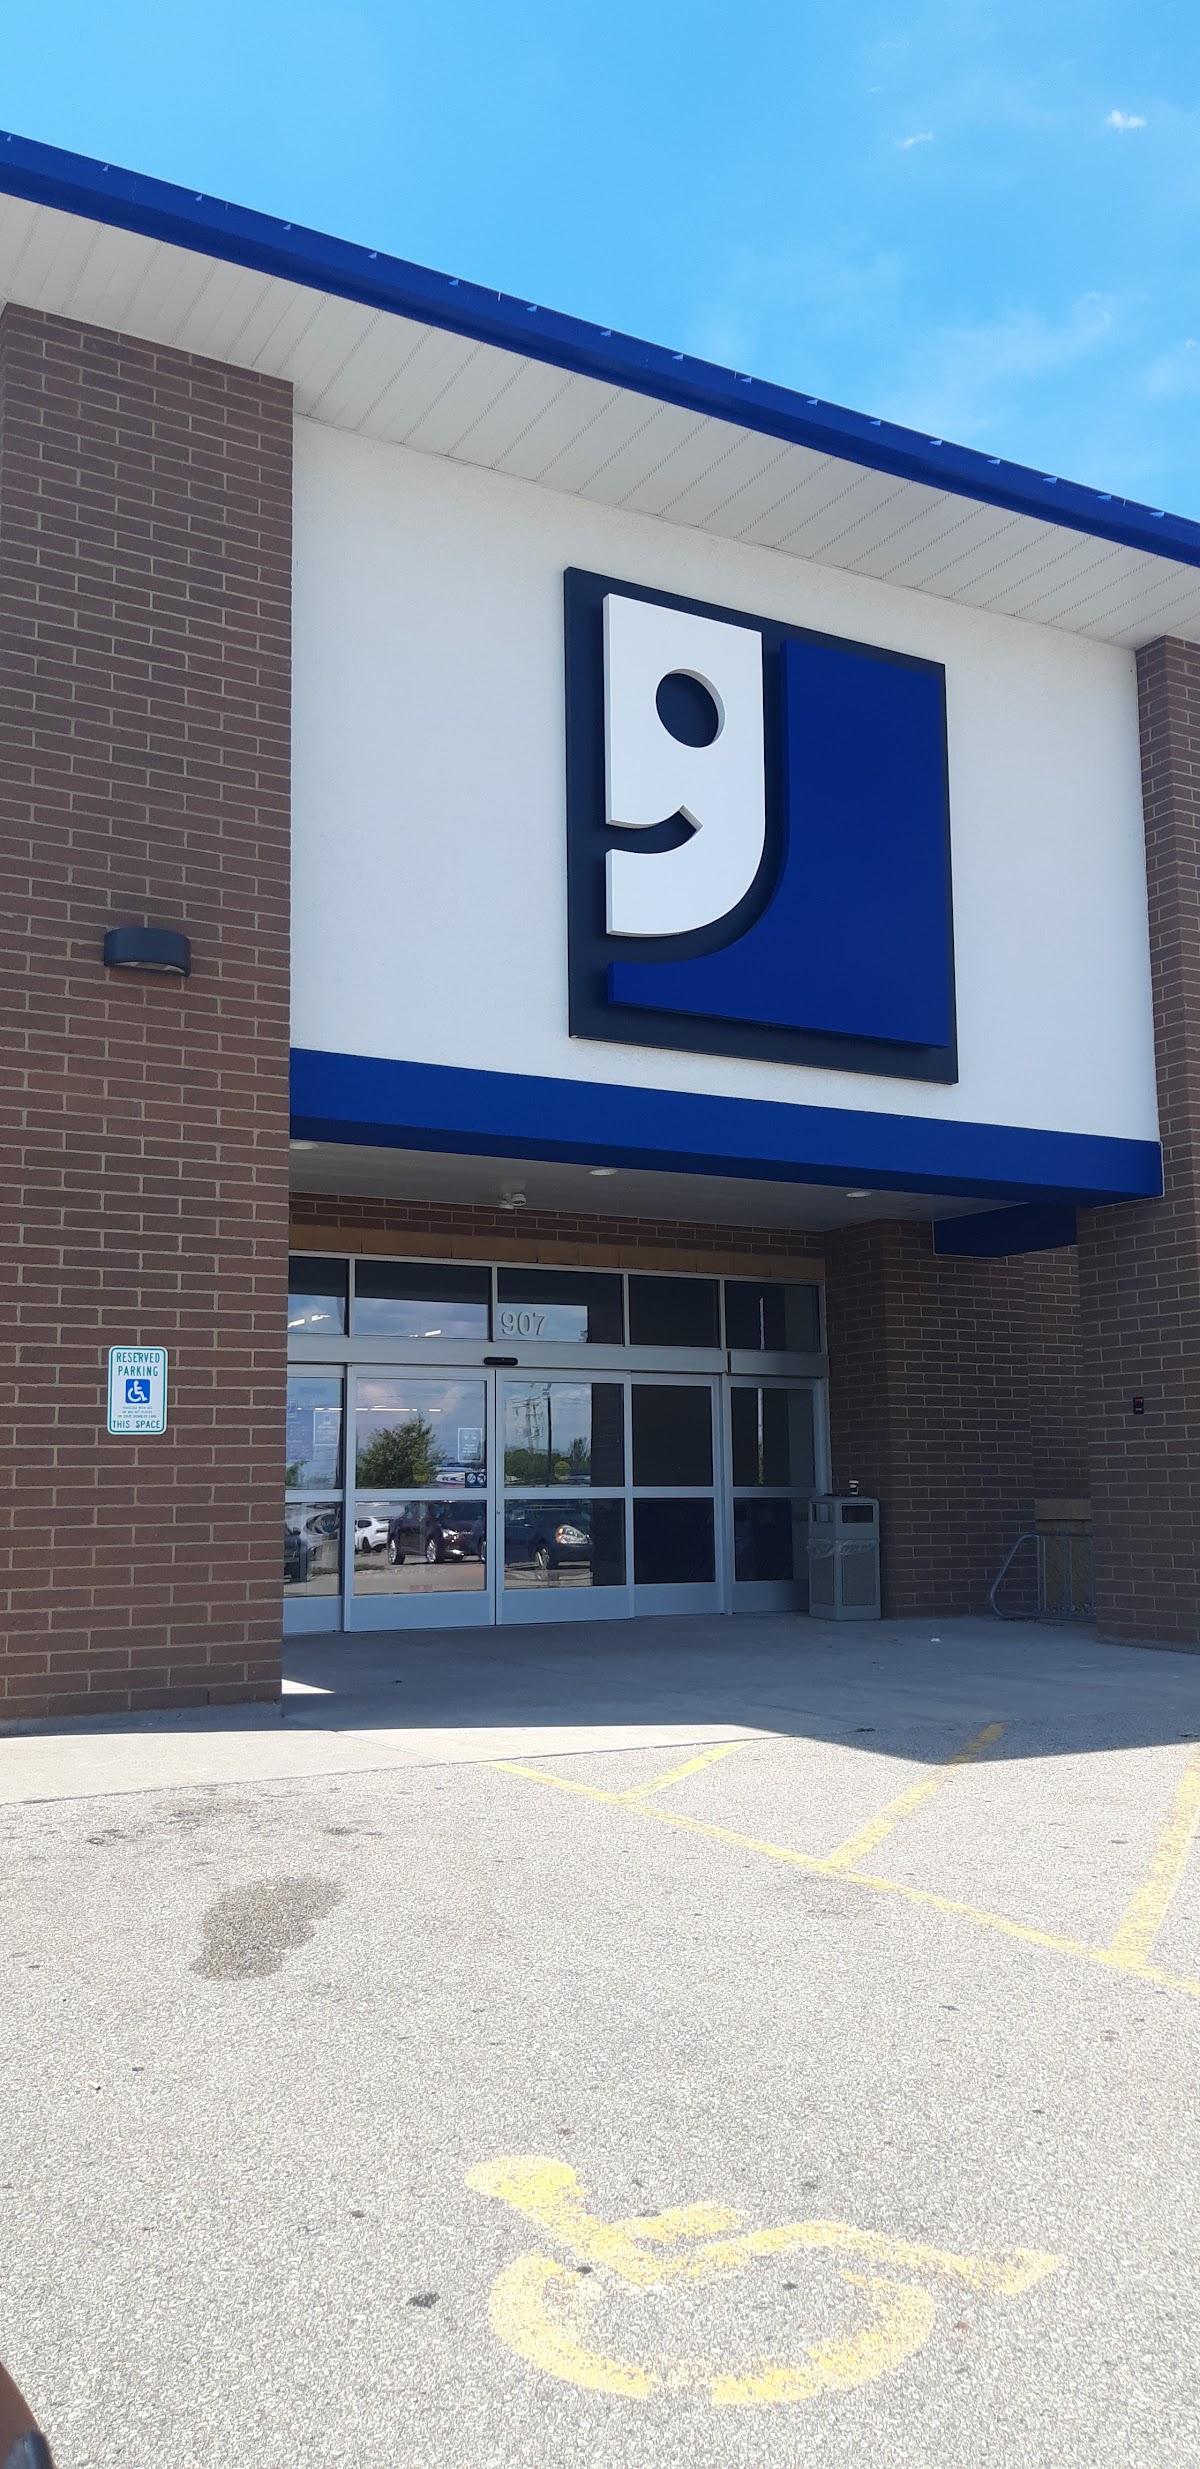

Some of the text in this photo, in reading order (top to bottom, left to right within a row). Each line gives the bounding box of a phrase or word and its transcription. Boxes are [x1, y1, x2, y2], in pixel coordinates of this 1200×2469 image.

[501, 1312, 546, 1336] 907
[117, 1352, 160, 1363] RESERVED
[118, 1366, 158, 1376] PARKING
[113, 1420, 160, 1428] THIS SPACE
